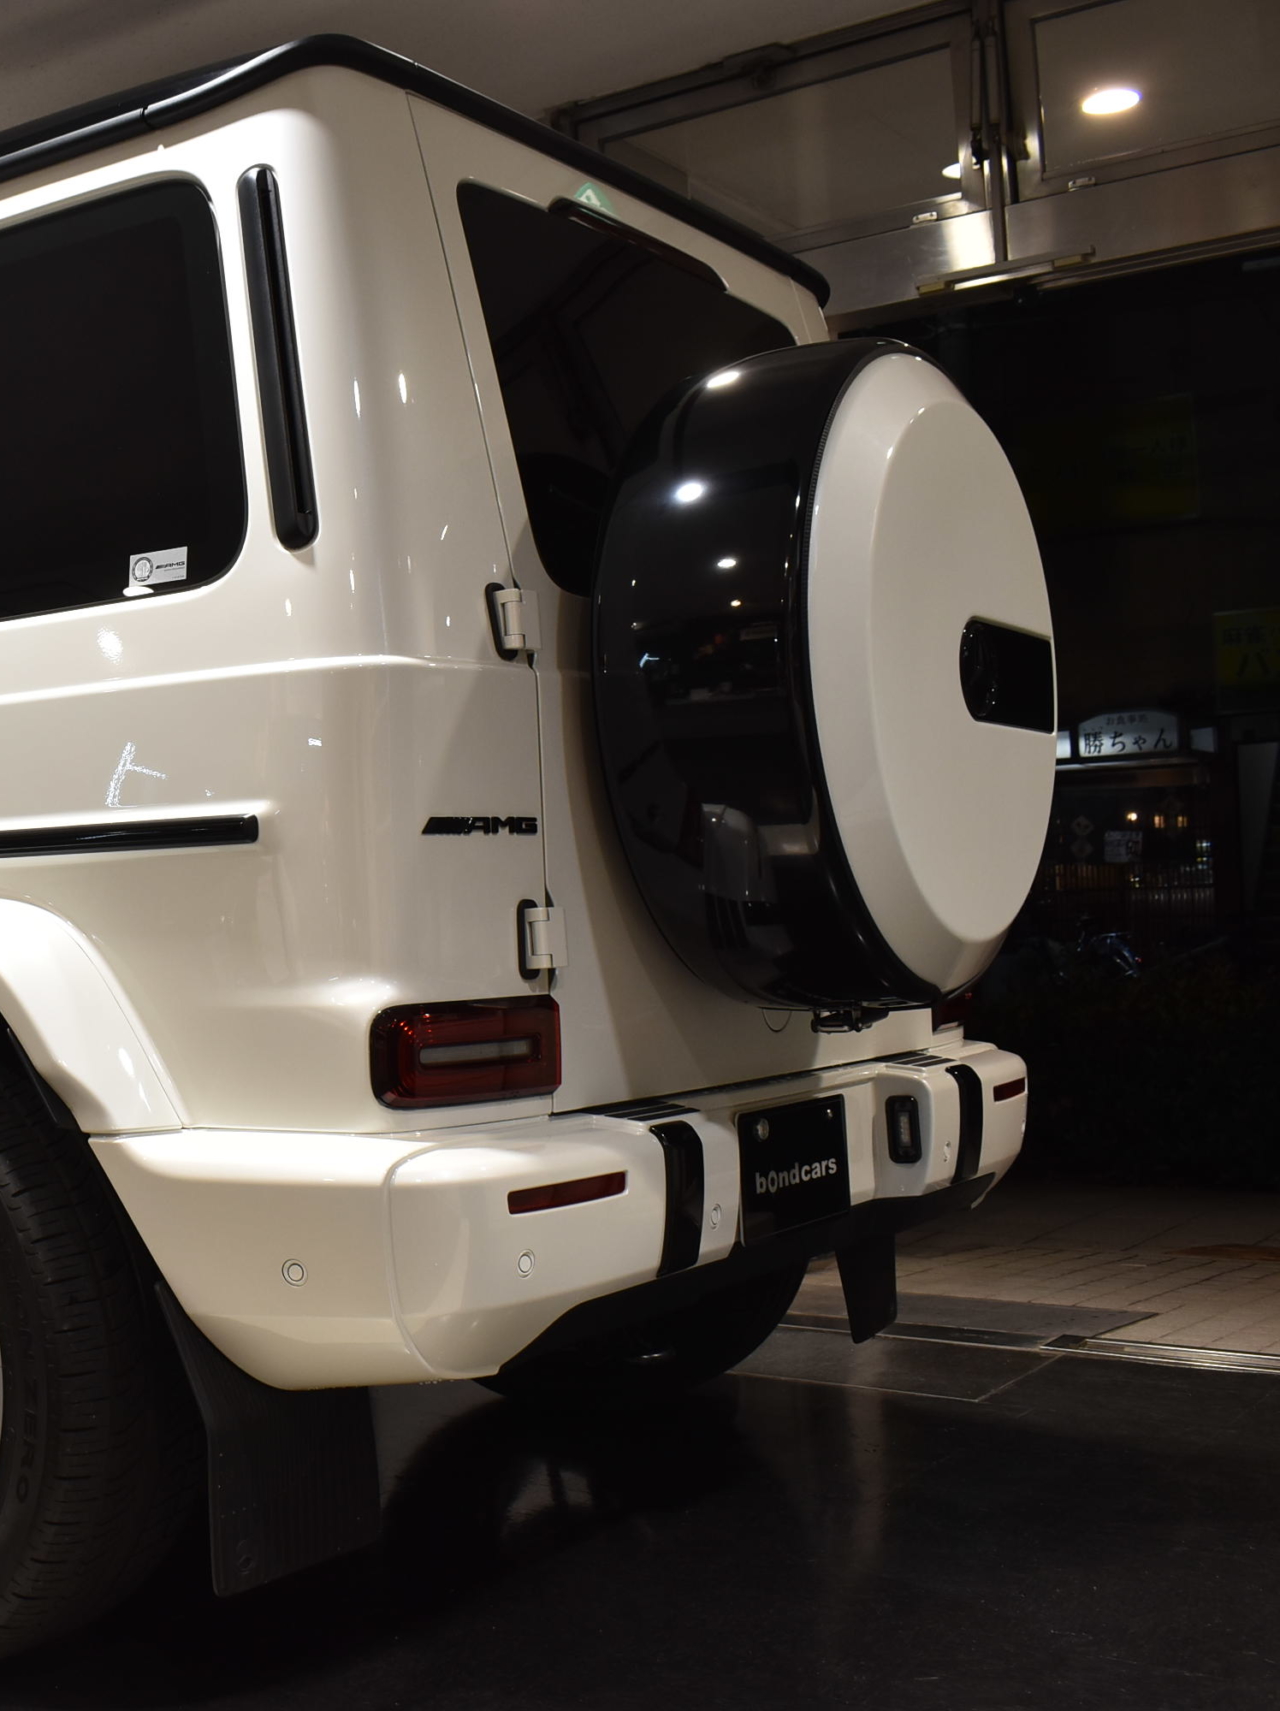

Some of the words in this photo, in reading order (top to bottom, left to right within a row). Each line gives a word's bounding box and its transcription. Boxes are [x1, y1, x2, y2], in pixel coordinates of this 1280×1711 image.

[1083, 728, 1173, 755] 勝ちゃん
[461, 816, 538, 837] AMG
